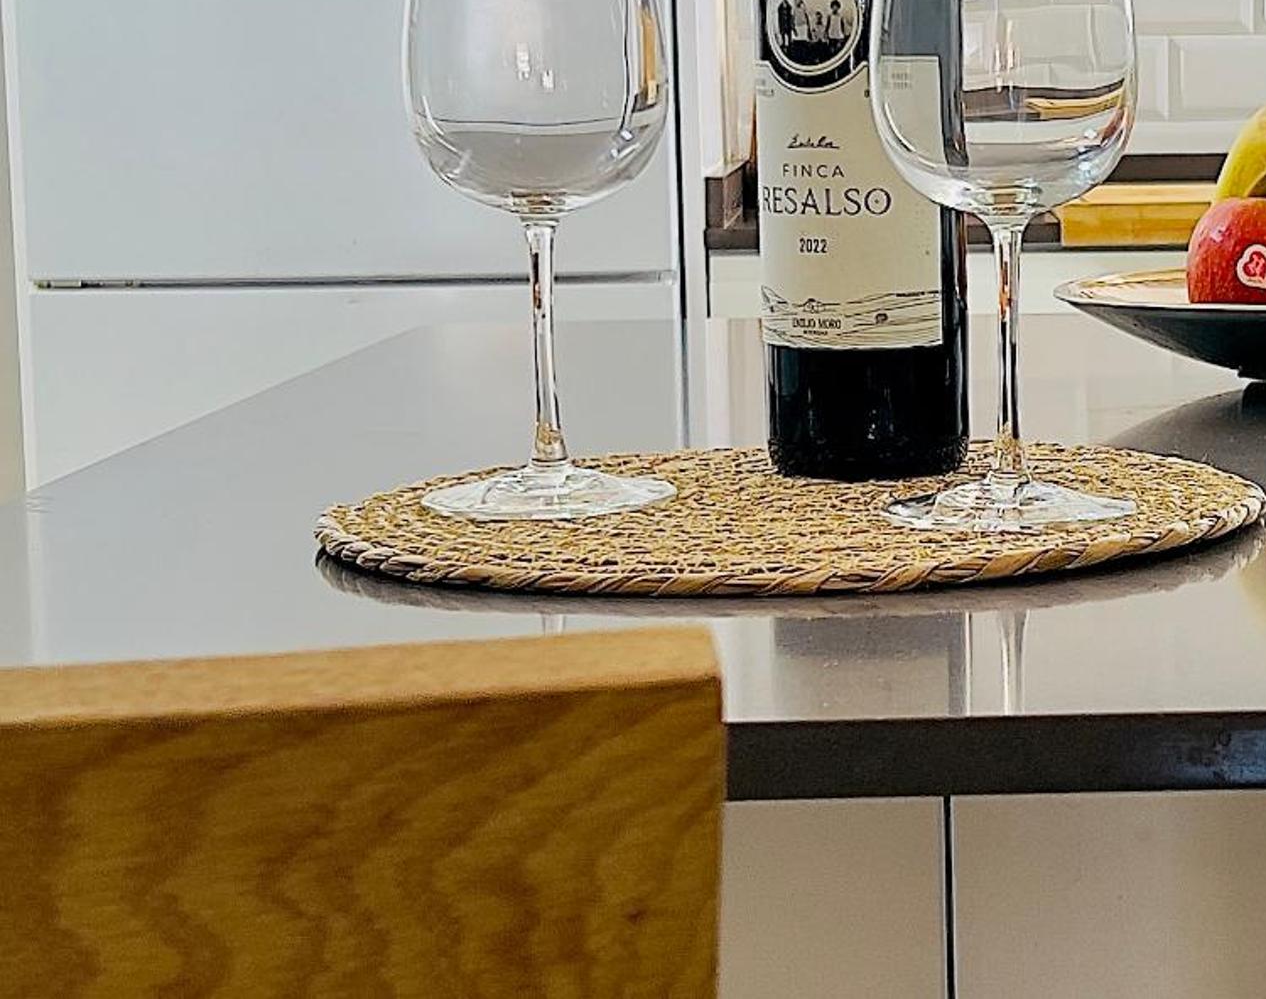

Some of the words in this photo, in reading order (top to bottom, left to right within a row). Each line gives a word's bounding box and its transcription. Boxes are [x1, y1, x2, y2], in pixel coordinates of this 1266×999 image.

[782, 163, 845, 179] FINCA
[762, 185, 893, 216] RESALSO
[799, 237, 828, 254] 2022
